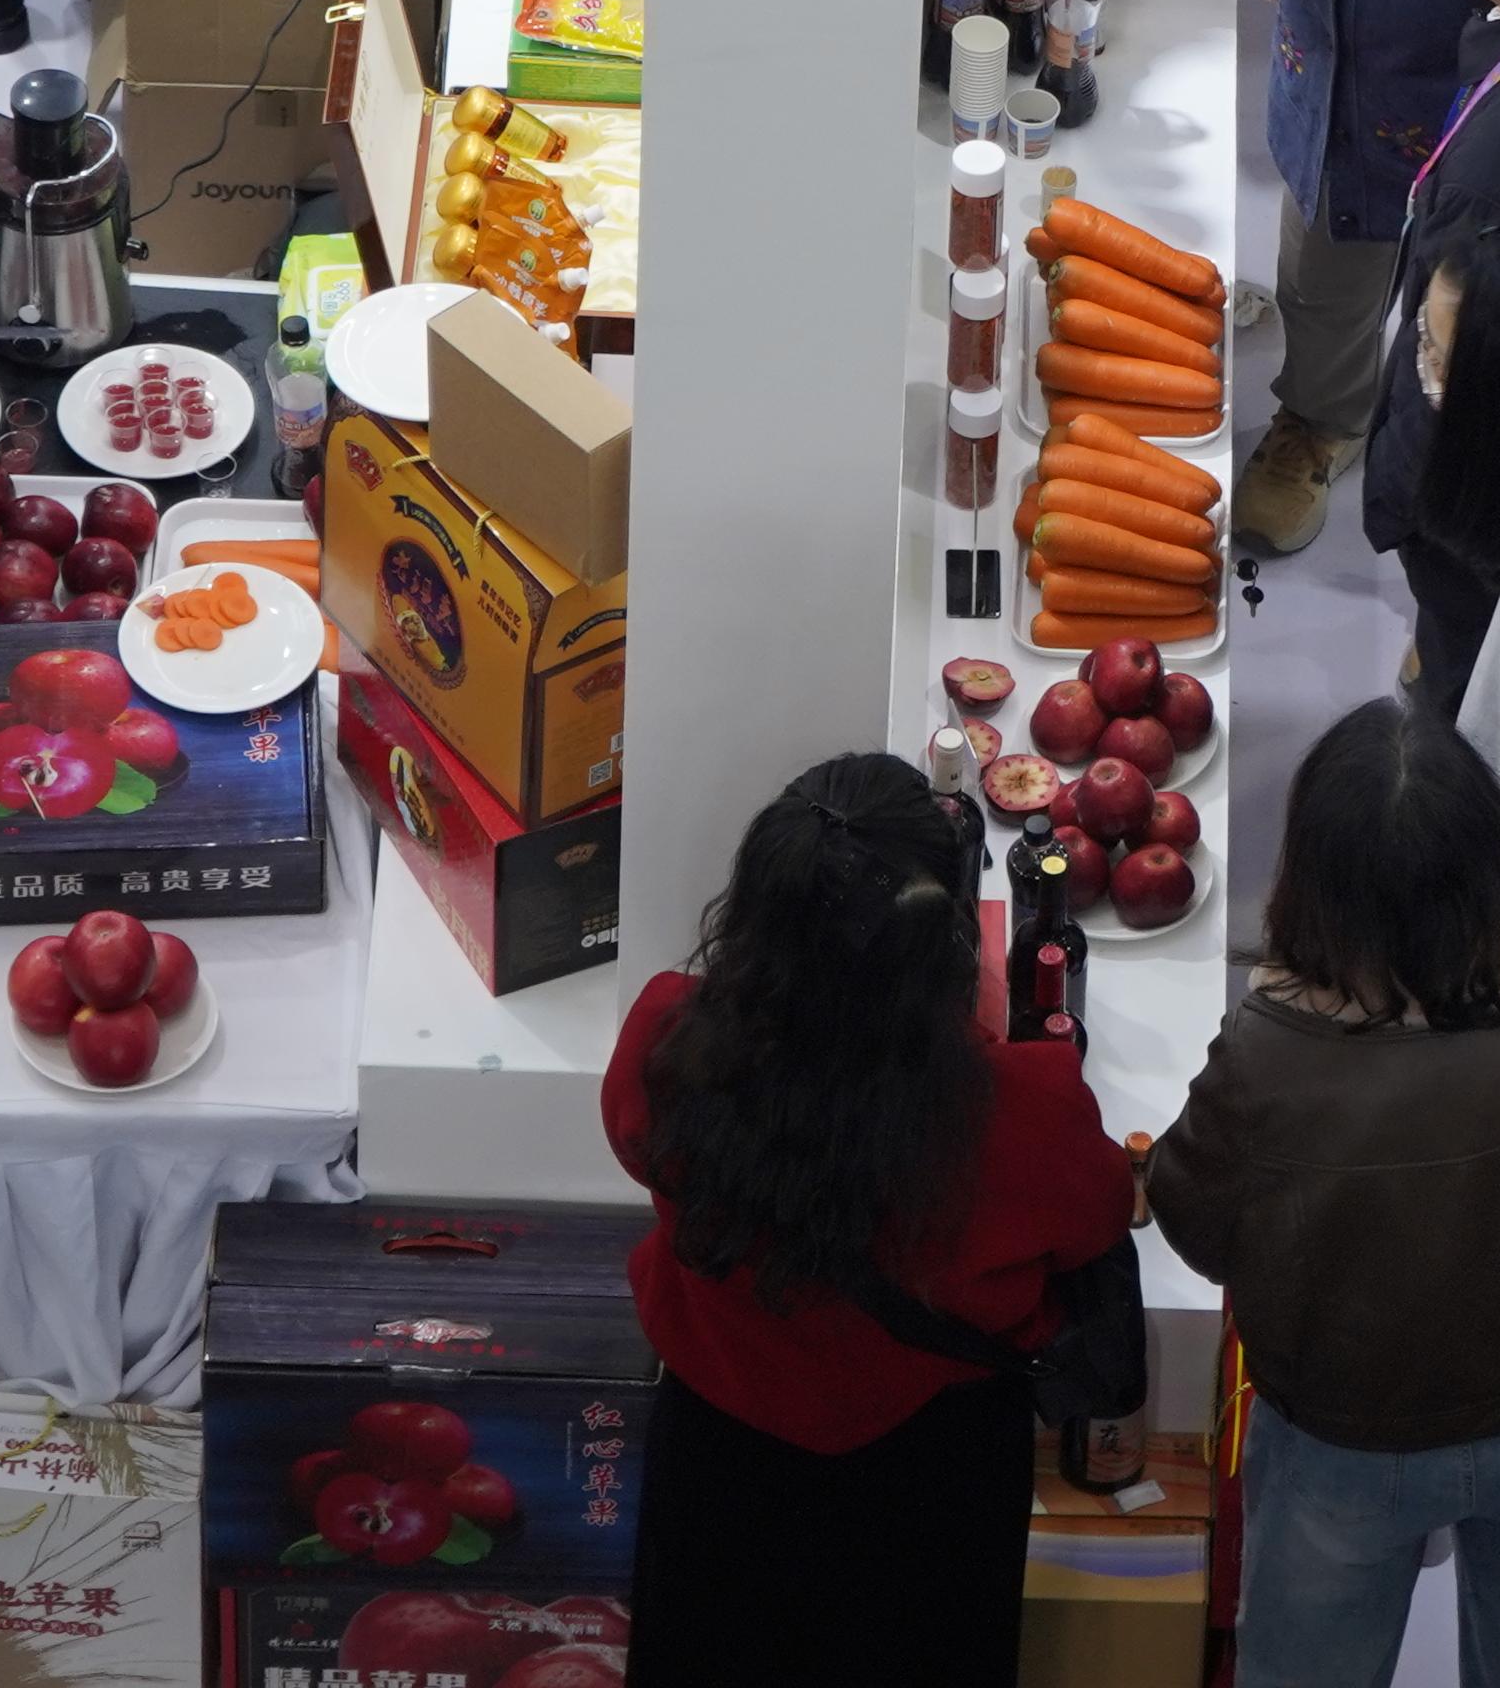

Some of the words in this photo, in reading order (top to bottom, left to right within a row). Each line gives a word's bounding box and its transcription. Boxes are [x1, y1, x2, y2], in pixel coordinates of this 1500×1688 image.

[120, 865, 275, 895] 高贵享受
[580, 1400, 625, 1528] 红心苹果
